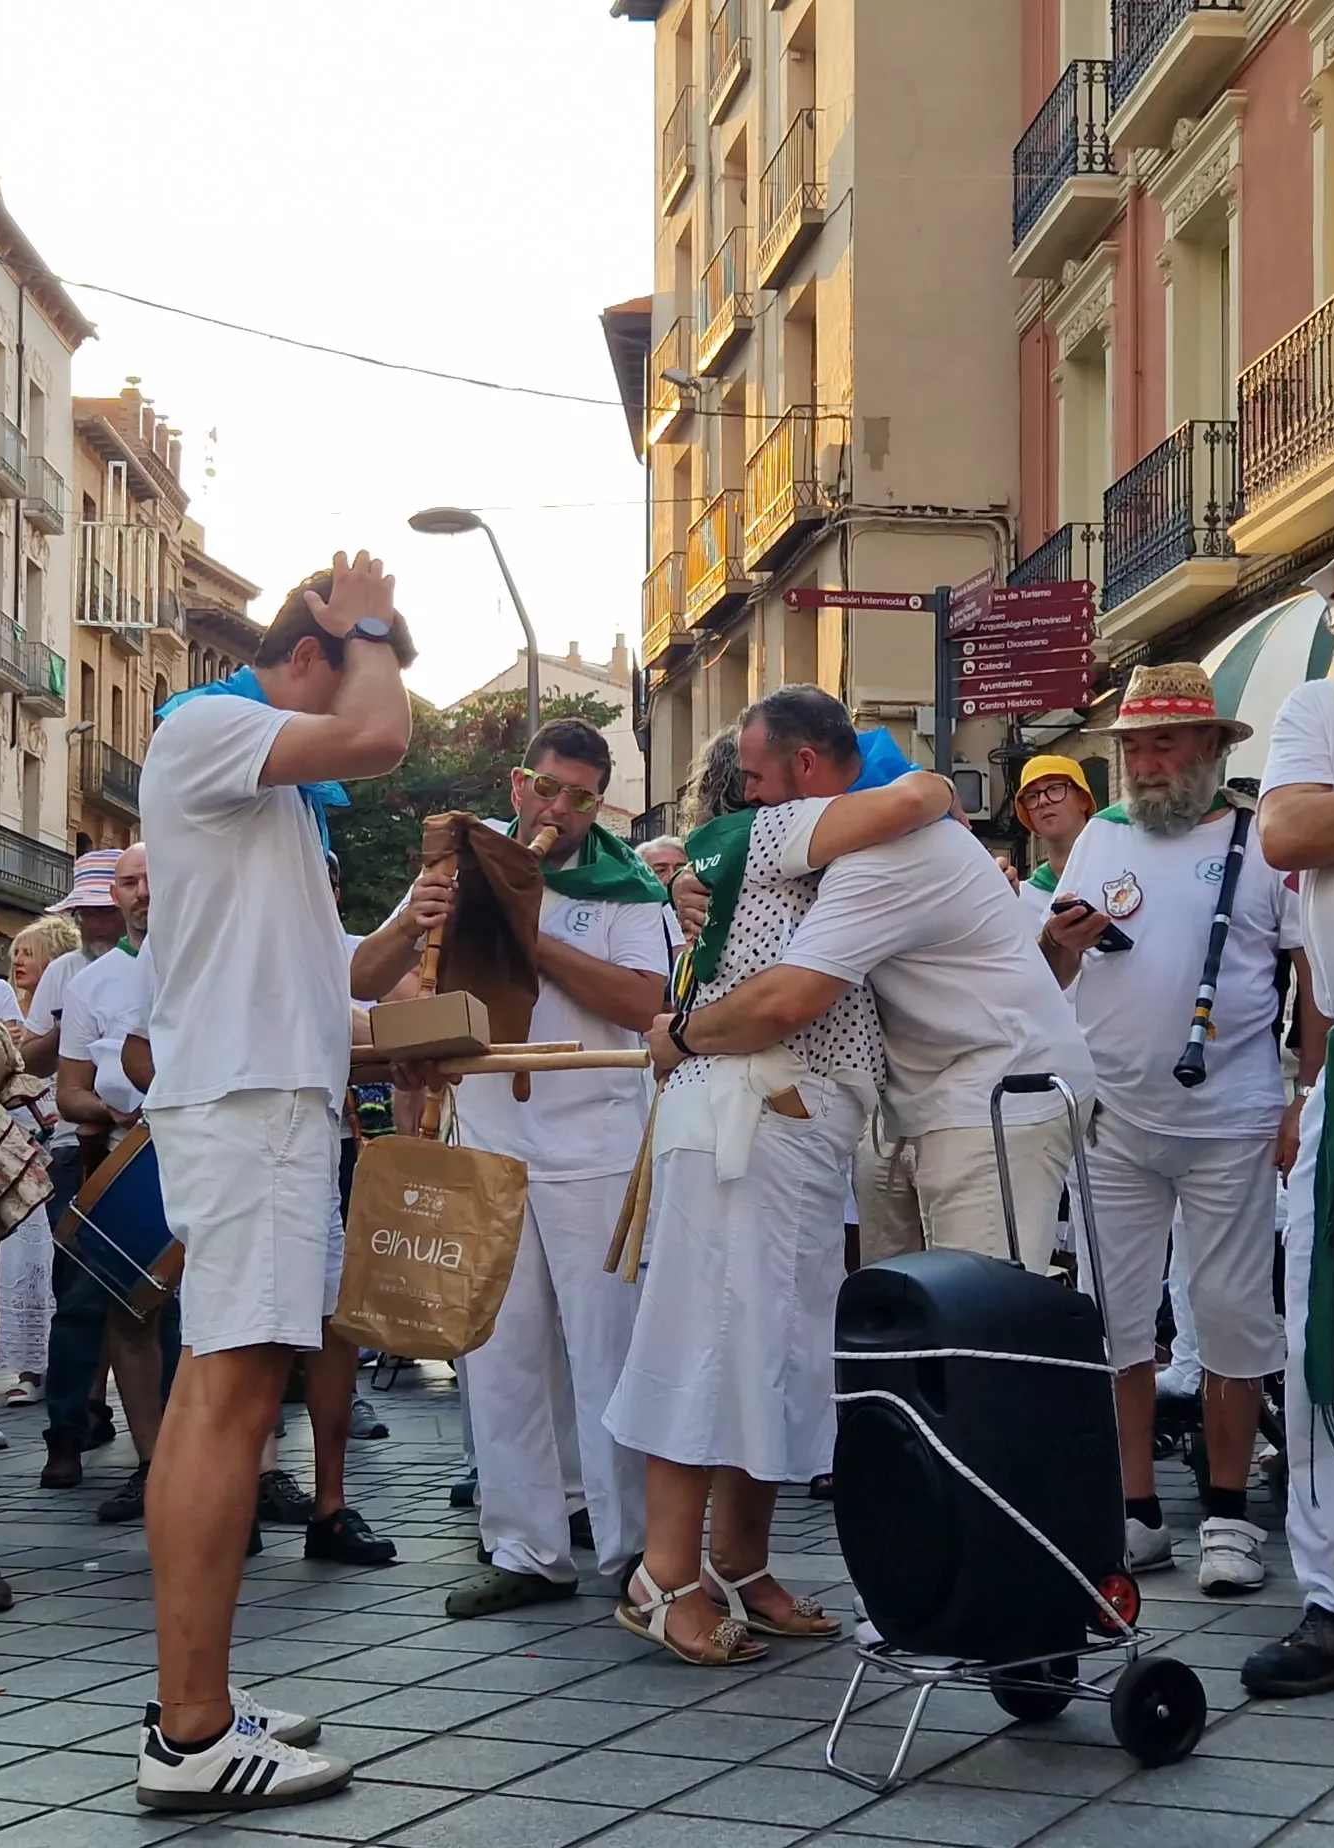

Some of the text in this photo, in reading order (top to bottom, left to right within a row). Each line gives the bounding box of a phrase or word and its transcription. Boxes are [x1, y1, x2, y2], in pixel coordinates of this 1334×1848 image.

[824, 594, 906, 606] Estación Intermodal
[1008, 592, 1018, 600] de
[1020, 590, 1052, 599] Turismo
[979, 614, 1071, 631] Arqueológico Provincial
[981, 614, 1006, 622] useo
[979, 639, 1048, 651] Museo Diocesano
[979, 660, 1012, 670] Catedral
[979, 680, 1033, 692] Ayuntamiento
[979, 699, 1043, 710] Centro Histórico
[371, 1229, 463, 1269] elhula
